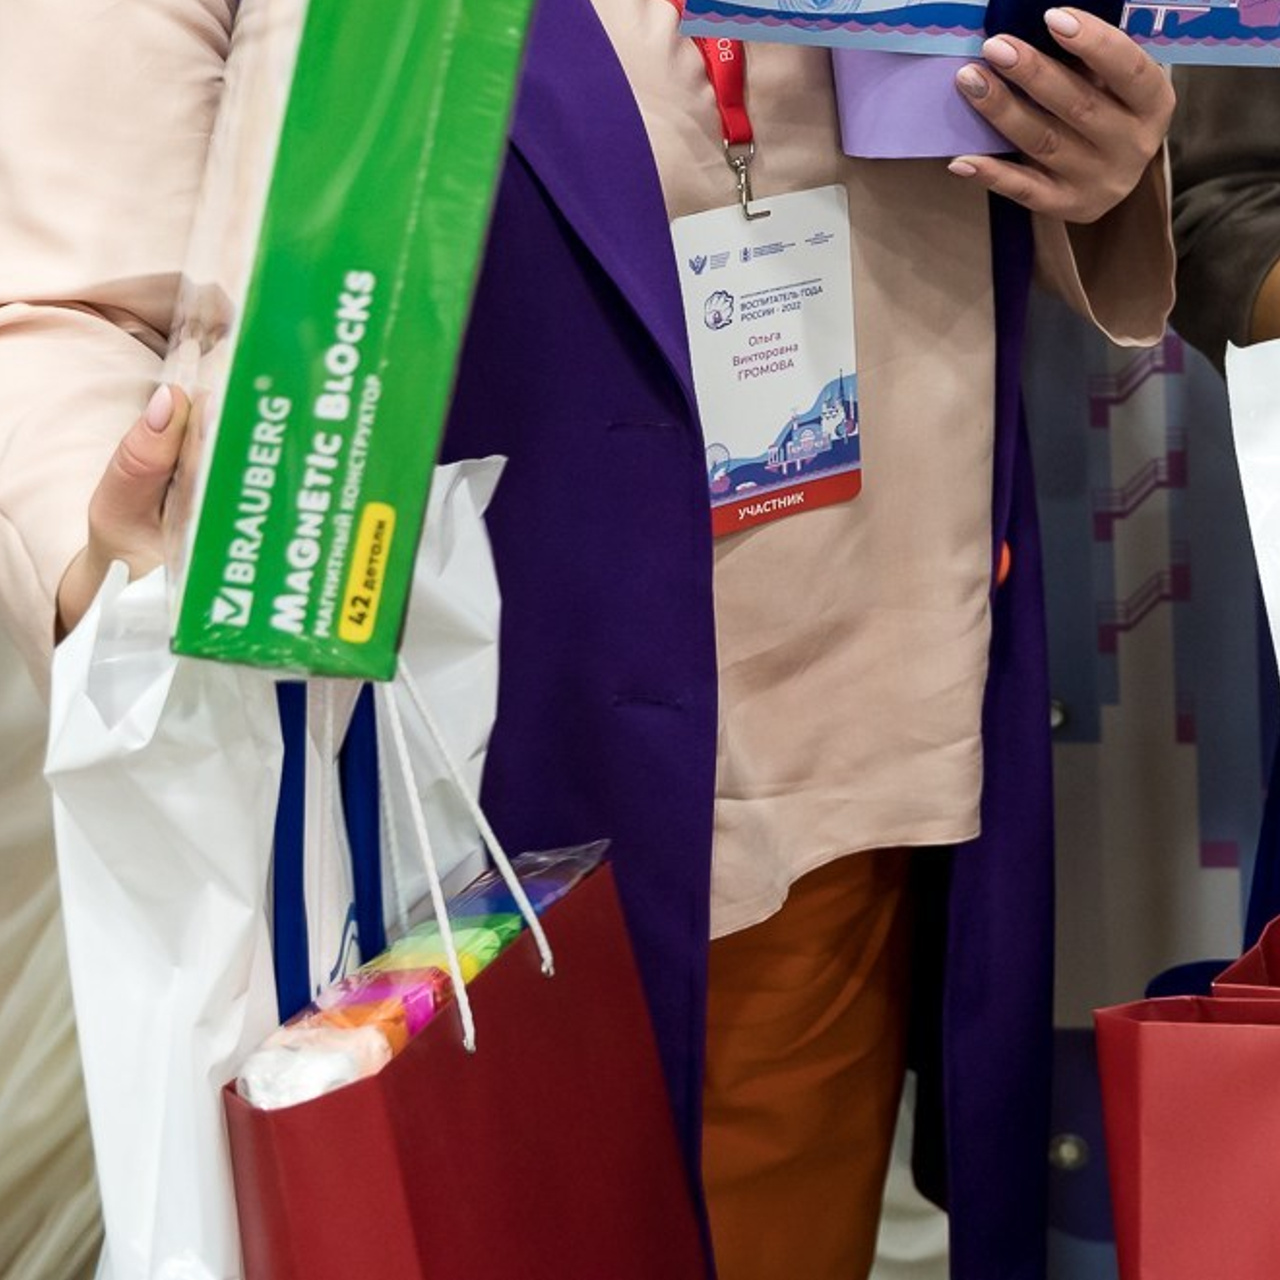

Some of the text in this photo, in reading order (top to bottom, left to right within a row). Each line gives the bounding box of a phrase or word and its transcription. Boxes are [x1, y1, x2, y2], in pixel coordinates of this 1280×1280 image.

[718, 38, 734, 62] ВО
[748, 332, 781, 347] Ольга
[733, 343, 799, 366] Викторовна
[738, 358, 794, 380] ГРОМОВА
[224, 396, 292, 584] BRAUBERG
[314, 374, 382, 638] МАГНИТНЫЙ КОНСТРУКТОР
[738, 492, 805, 519] УЧАСТНИК
[347, 595, 372, 626] 42
